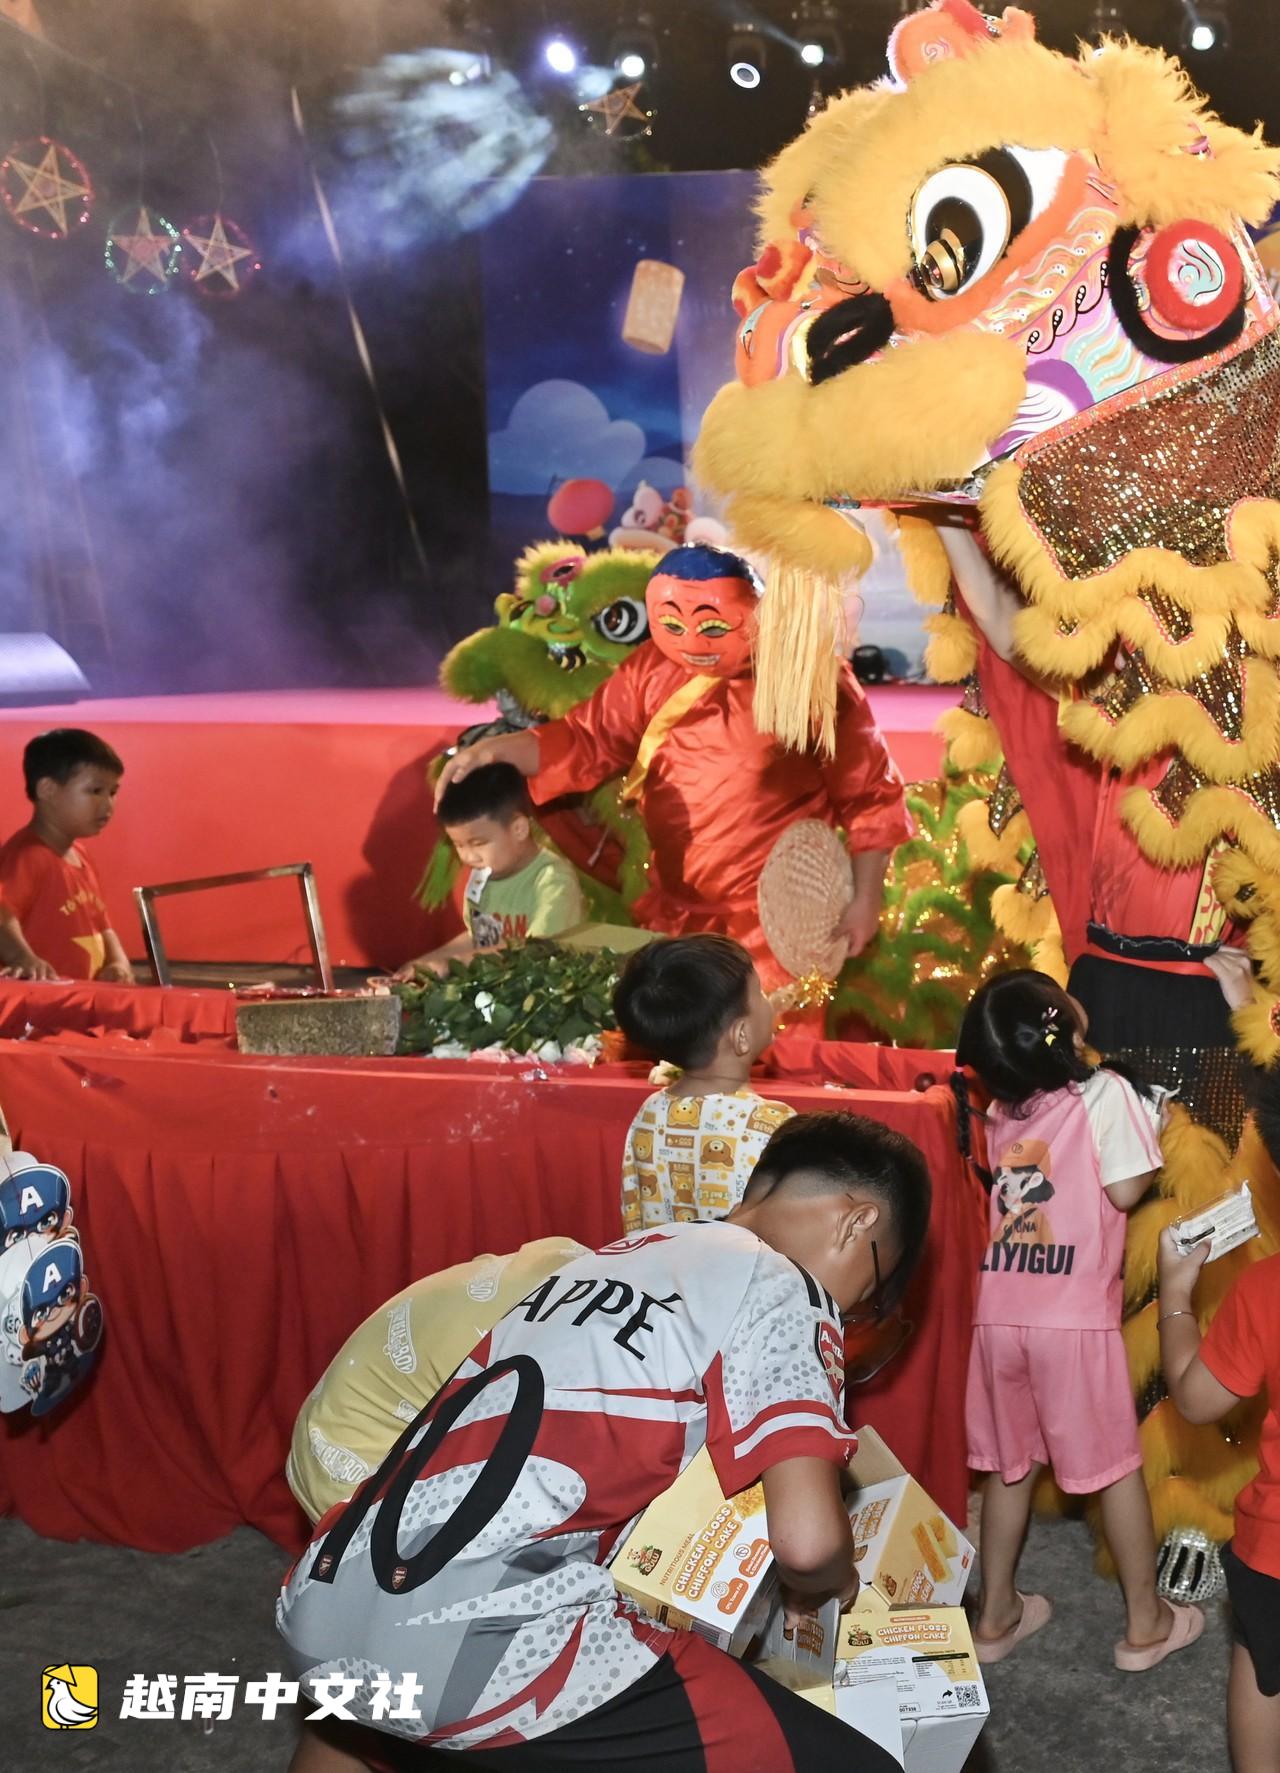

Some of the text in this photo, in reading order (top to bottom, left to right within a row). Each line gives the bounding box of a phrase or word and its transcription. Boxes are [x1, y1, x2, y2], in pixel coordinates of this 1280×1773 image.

[19, 1185, 44, 1215] A
[42, 1262, 62, 1293] A
[660, 1532, 696, 1586] NUTRITIOUS MEAL
[675, 1506, 732, 1592] CHICKEN FLOSS
[688, 1521, 738, 1598] CHIFFON CAKE
[878, 1624, 948, 1636] CHICKEN FLOSS
[883, 1632, 946, 1643] CHIFFON CAKE
